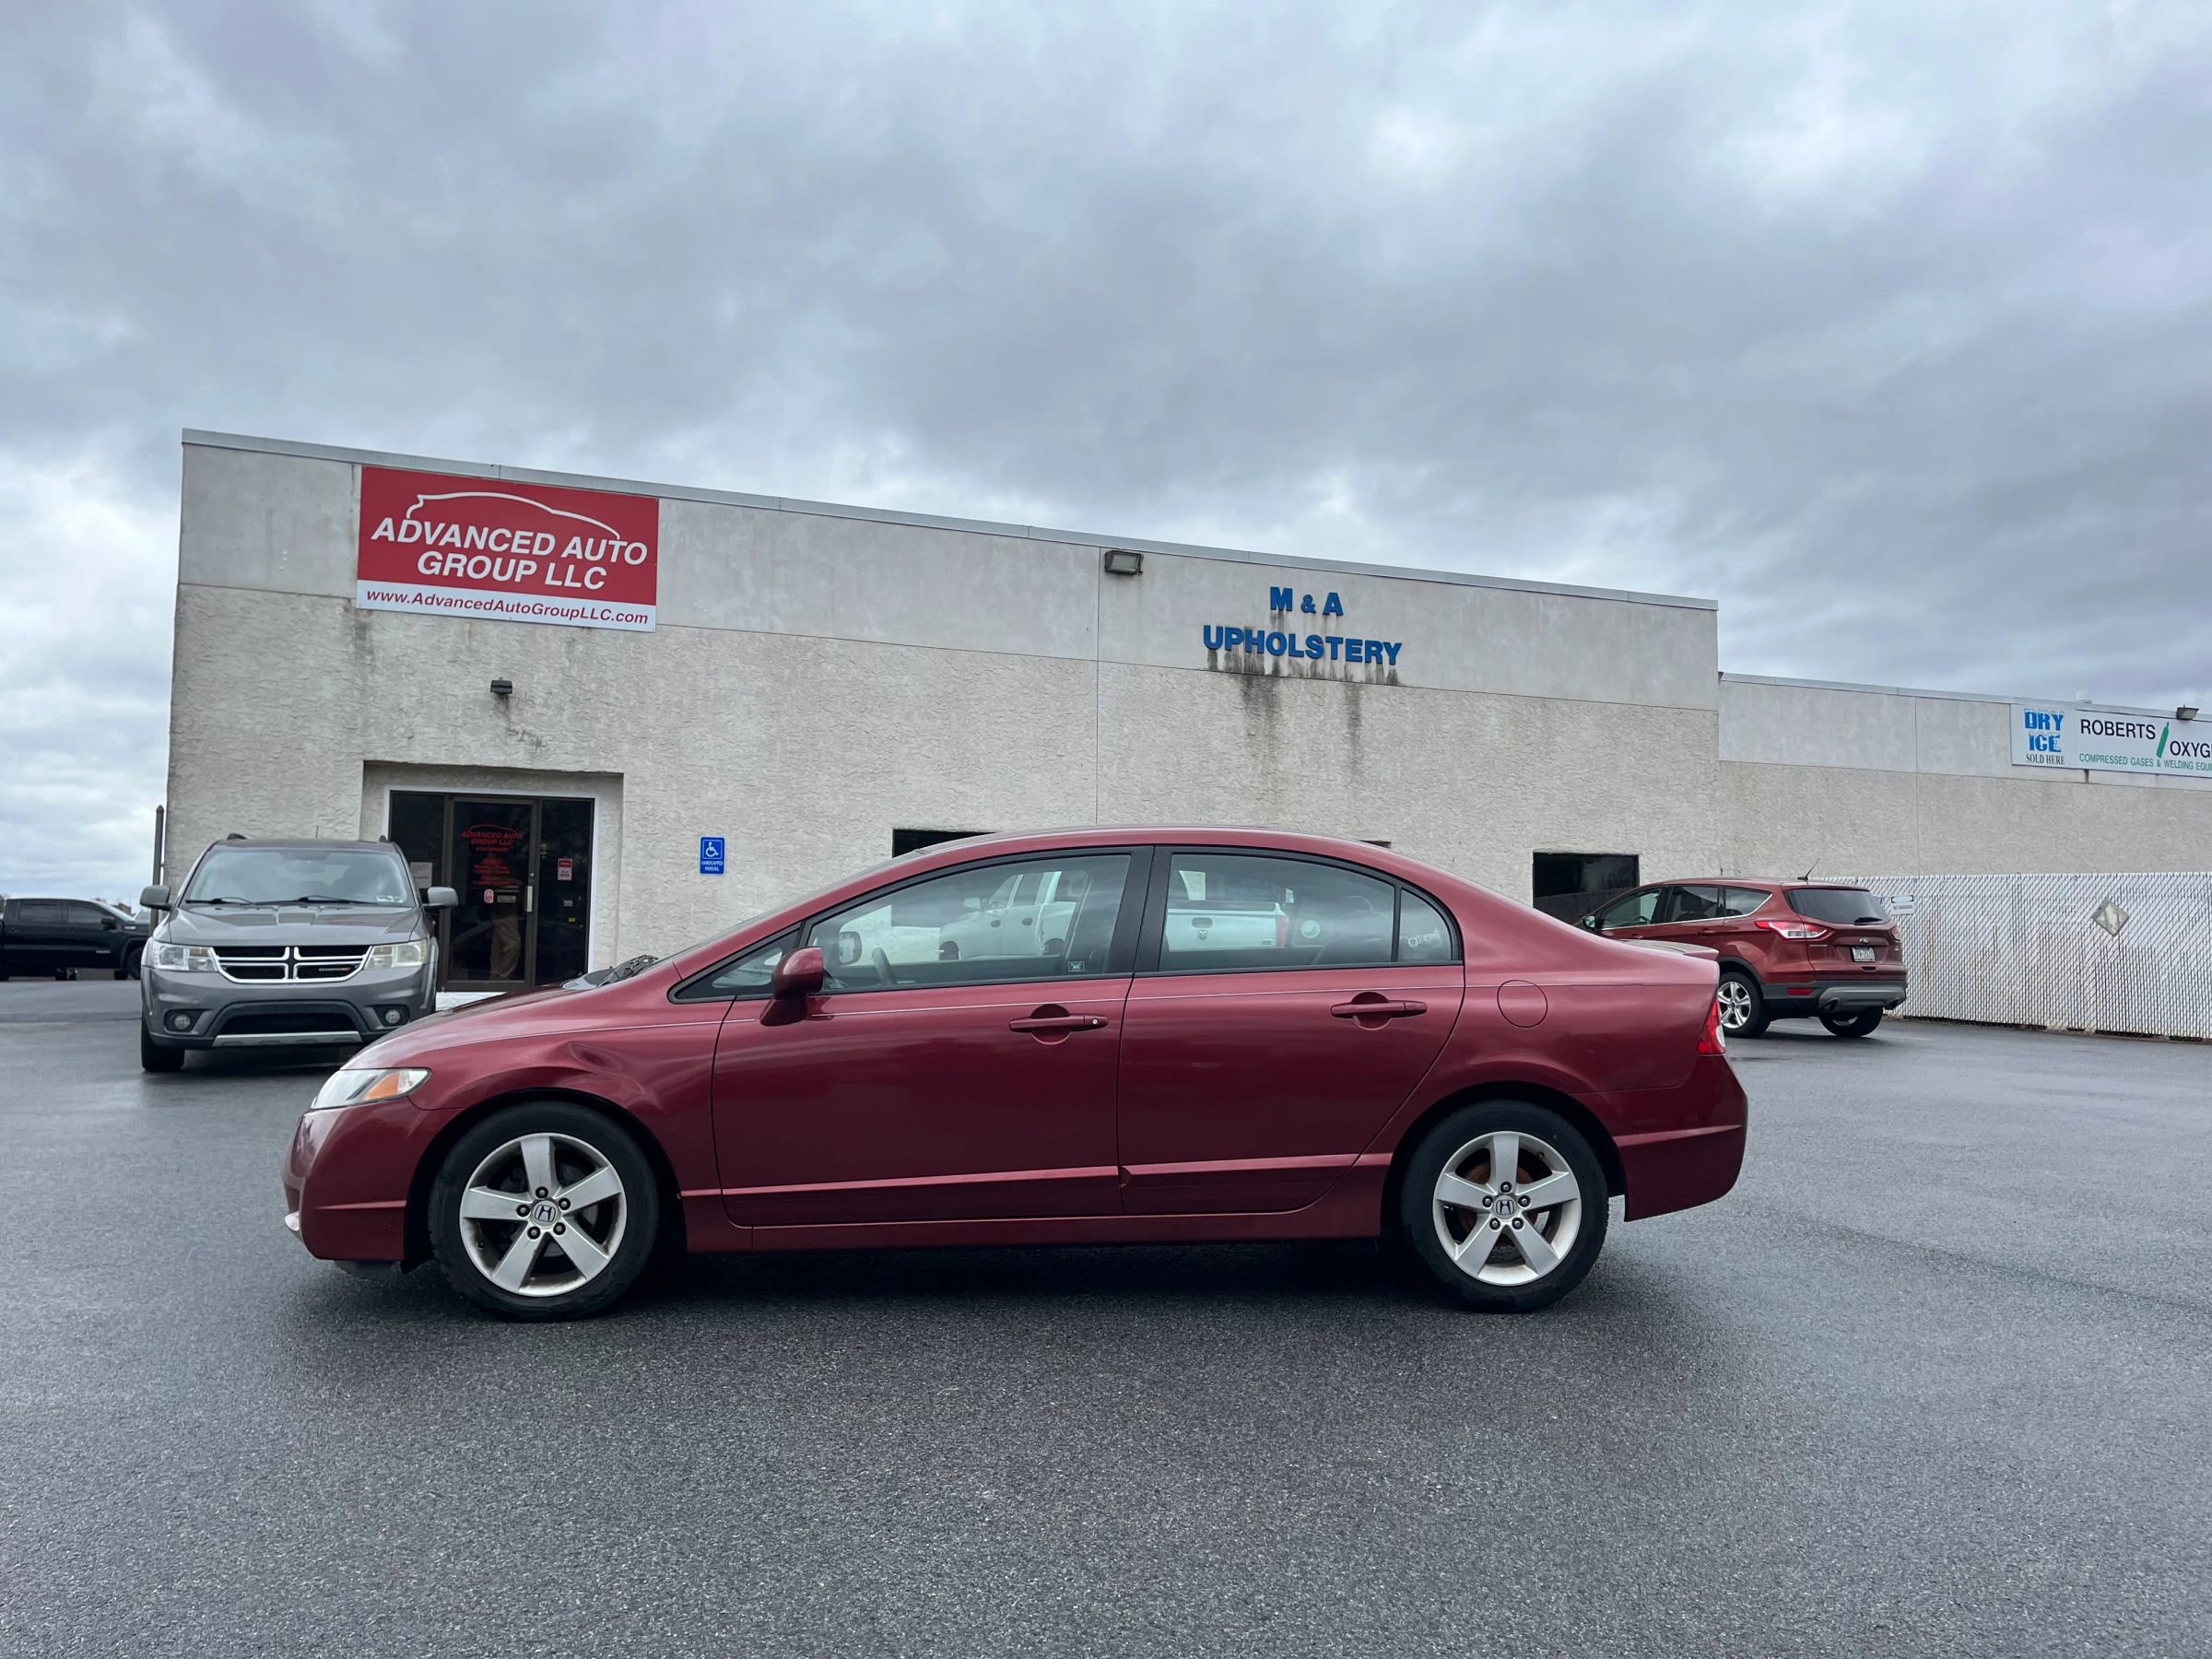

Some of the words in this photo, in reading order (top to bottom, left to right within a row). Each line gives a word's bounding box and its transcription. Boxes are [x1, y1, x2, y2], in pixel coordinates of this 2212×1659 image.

[371, 517, 556, 556] ADVANCED
[560, 536, 648, 565] AUTO
[418, 551, 537, 582] GROUP
[545, 563, 607, 590] LLC
[367, 590, 649, 625] www.AdvancedAutoGroupLLC.com
[1270, 586, 1293, 611] M
[1300, 594, 1316, 614] &
[1323, 592, 1344, 616] A
[1203, 625, 1403, 665] UPHOLSTERY
[2024, 708, 2064, 731] DRY
[2080, 719, 2156, 740] ROBERTS
[2029, 731, 2062, 752] ICE
[2170, 740, 2212, 759] OXYG
[2026, 753, 2044, 764] SOLD
[2046, 755, 2065, 765] HERE
[2079, 753, 2128, 765] COMPRESSED
[2130, 757, 2154, 768] GASES
[2157, 759, 2161, 768] &
[2164, 759, 2194, 771] WELDING
